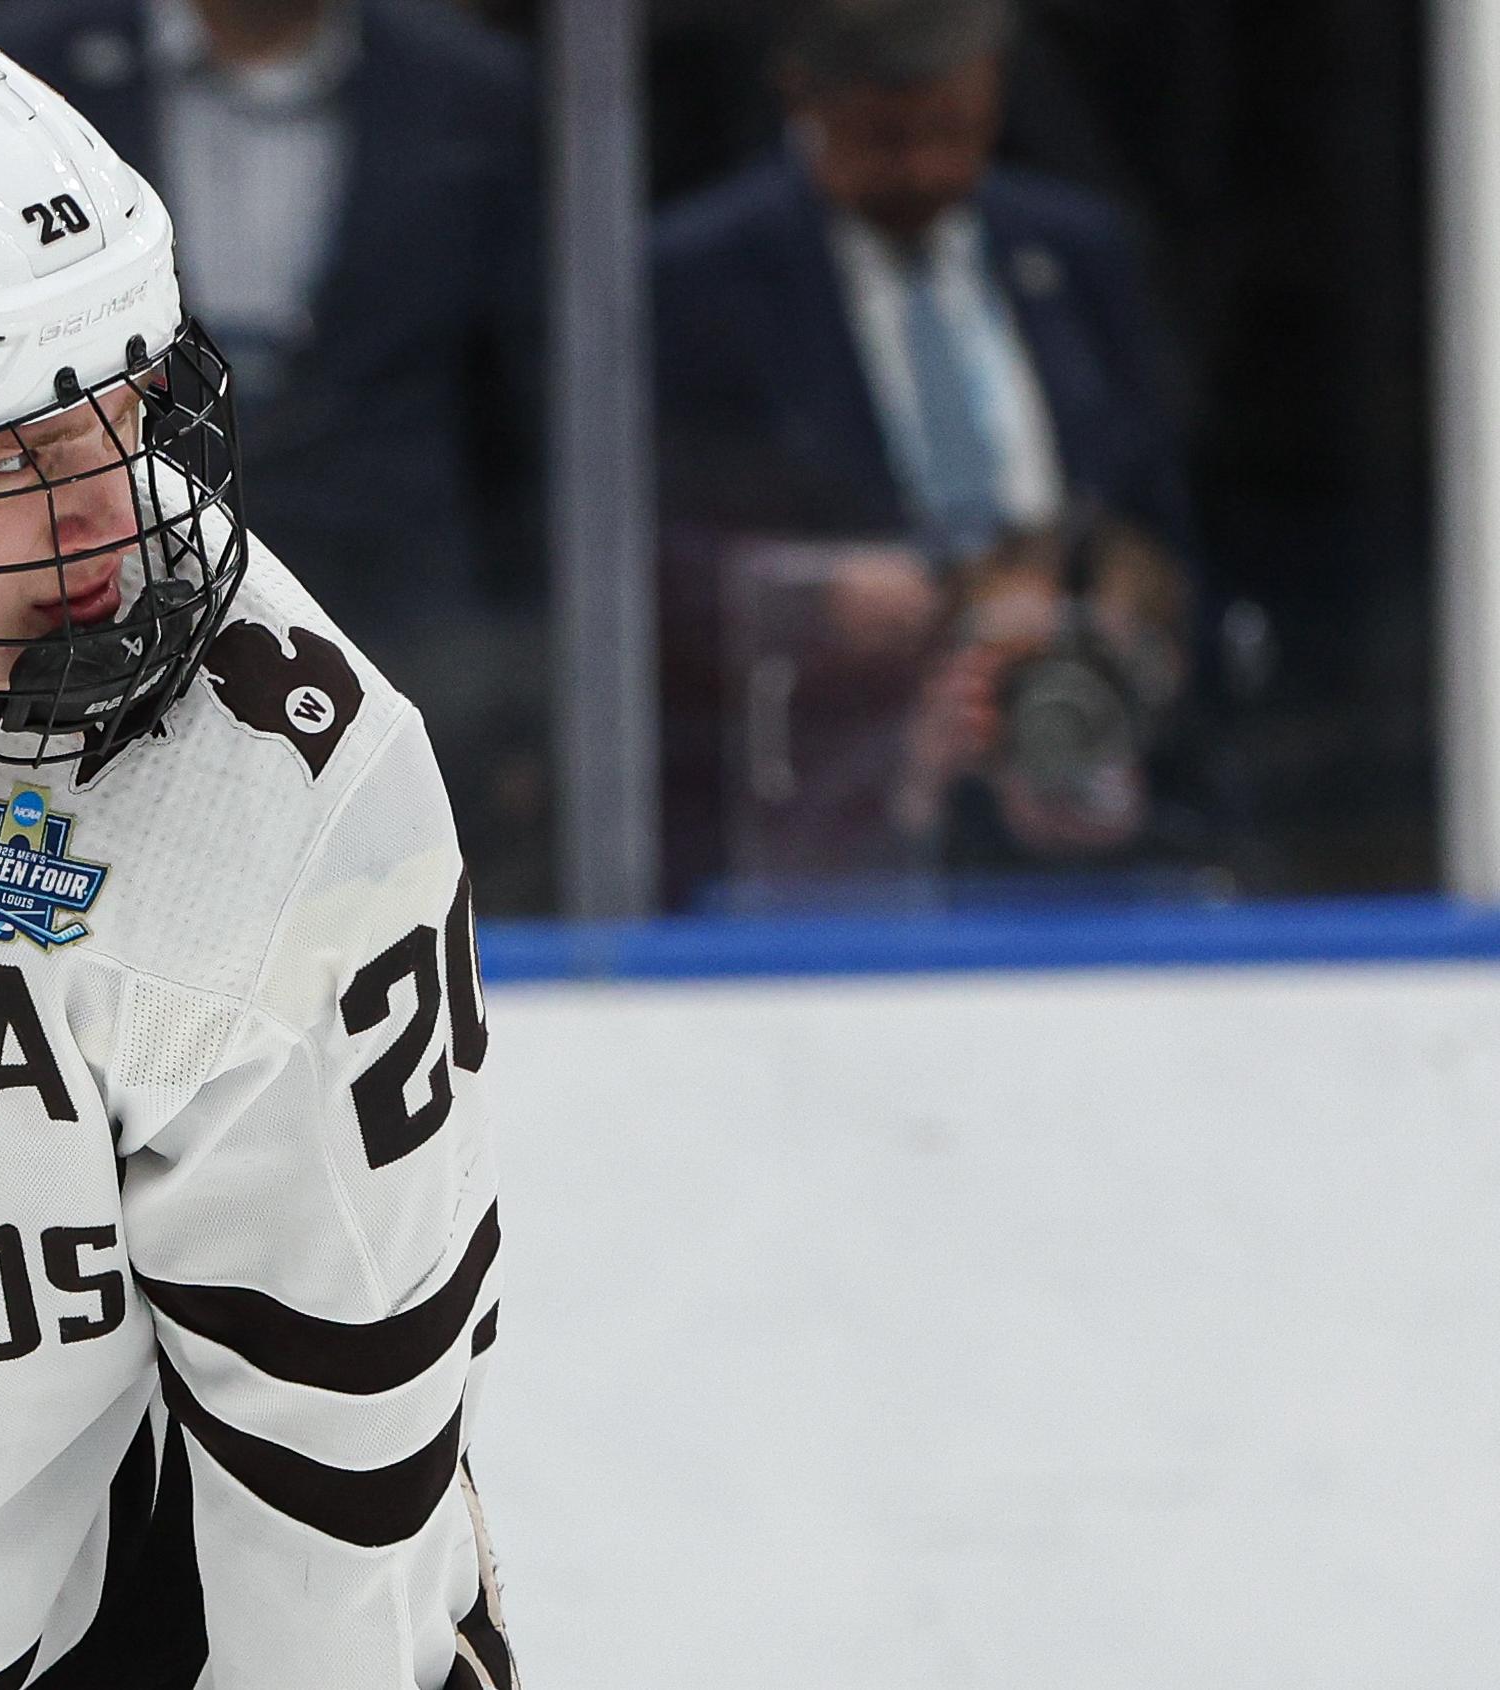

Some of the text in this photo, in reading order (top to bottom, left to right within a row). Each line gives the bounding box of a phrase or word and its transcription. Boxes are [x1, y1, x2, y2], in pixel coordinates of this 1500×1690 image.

[21, 193, 90, 245] 20
[293, 692, 327, 723] W
[13, 805, 42, 820] NCAA
[16, 850, 47, 864] MEN'S
[28, 864, 89, 900] FOUR
[1, 892, 35, 909] LOUIS
[338, 862, 488, 1170] 20
